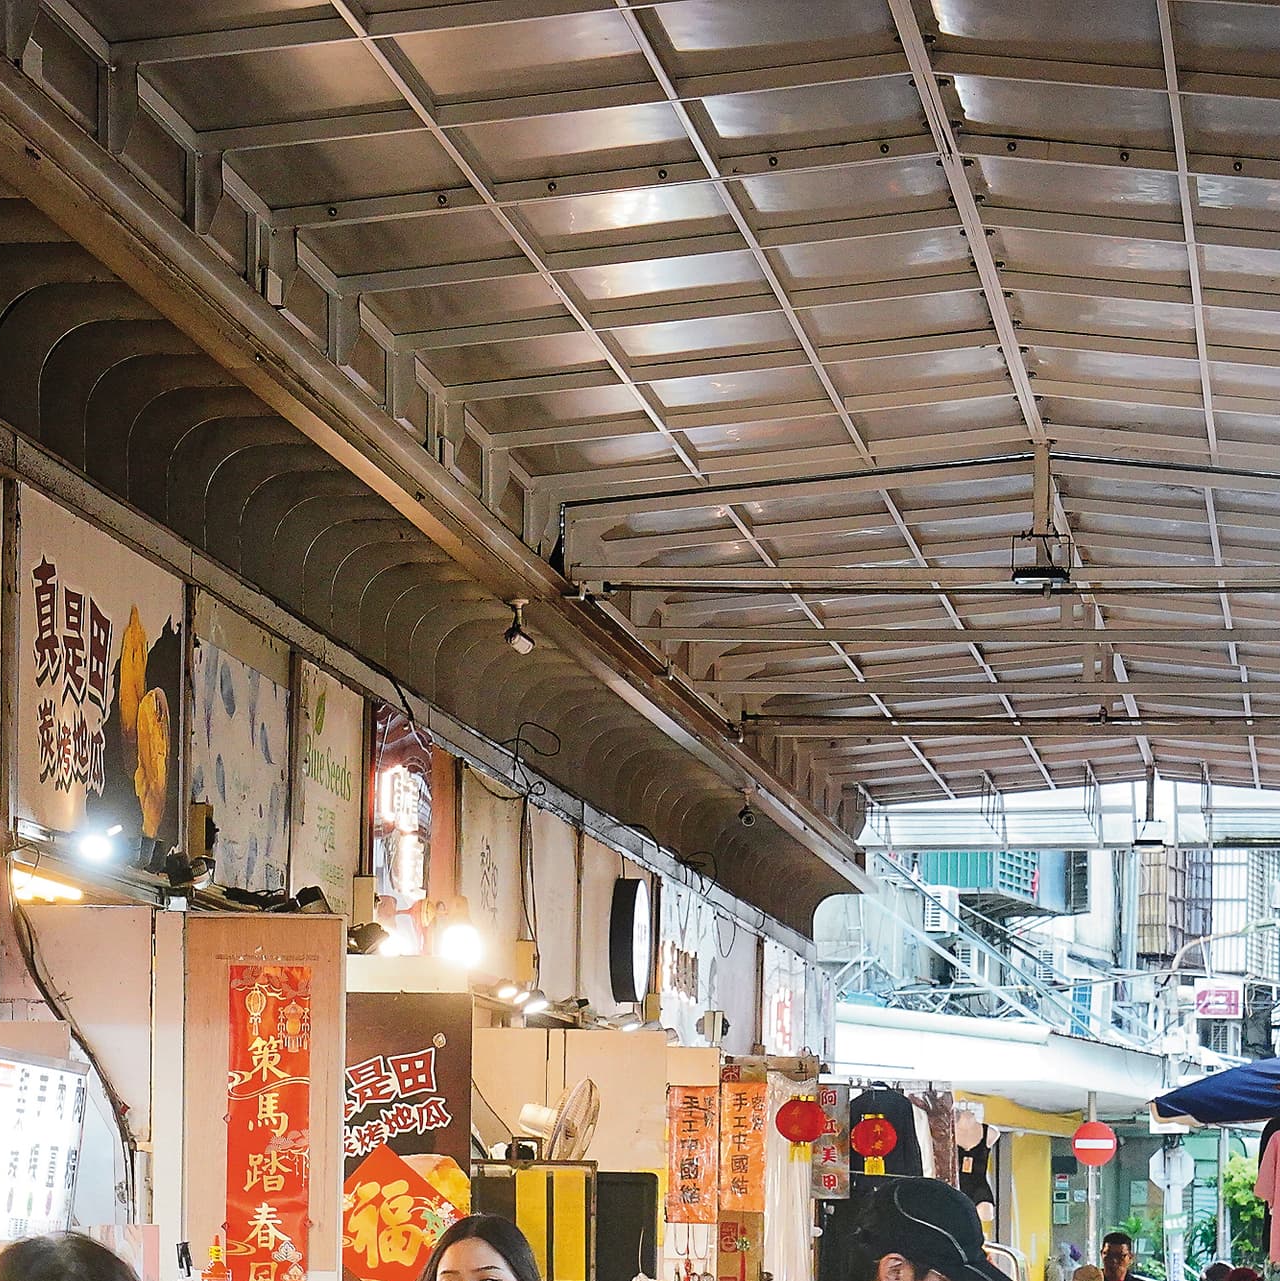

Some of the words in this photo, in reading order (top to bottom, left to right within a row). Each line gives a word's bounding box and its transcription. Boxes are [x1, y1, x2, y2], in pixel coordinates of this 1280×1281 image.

[32, 554, 111, 715] 真是田
[37, 699, 106, 797] 炭烤地瓜
[304, 734, 326, 787] Blue
[325, 747, 352, 802] Seeds
[344, 1047, 437, 1121] 是田
[730, 1091, 749, 1196] 手工中國結
[350, 1178, 424, 1271] 福
